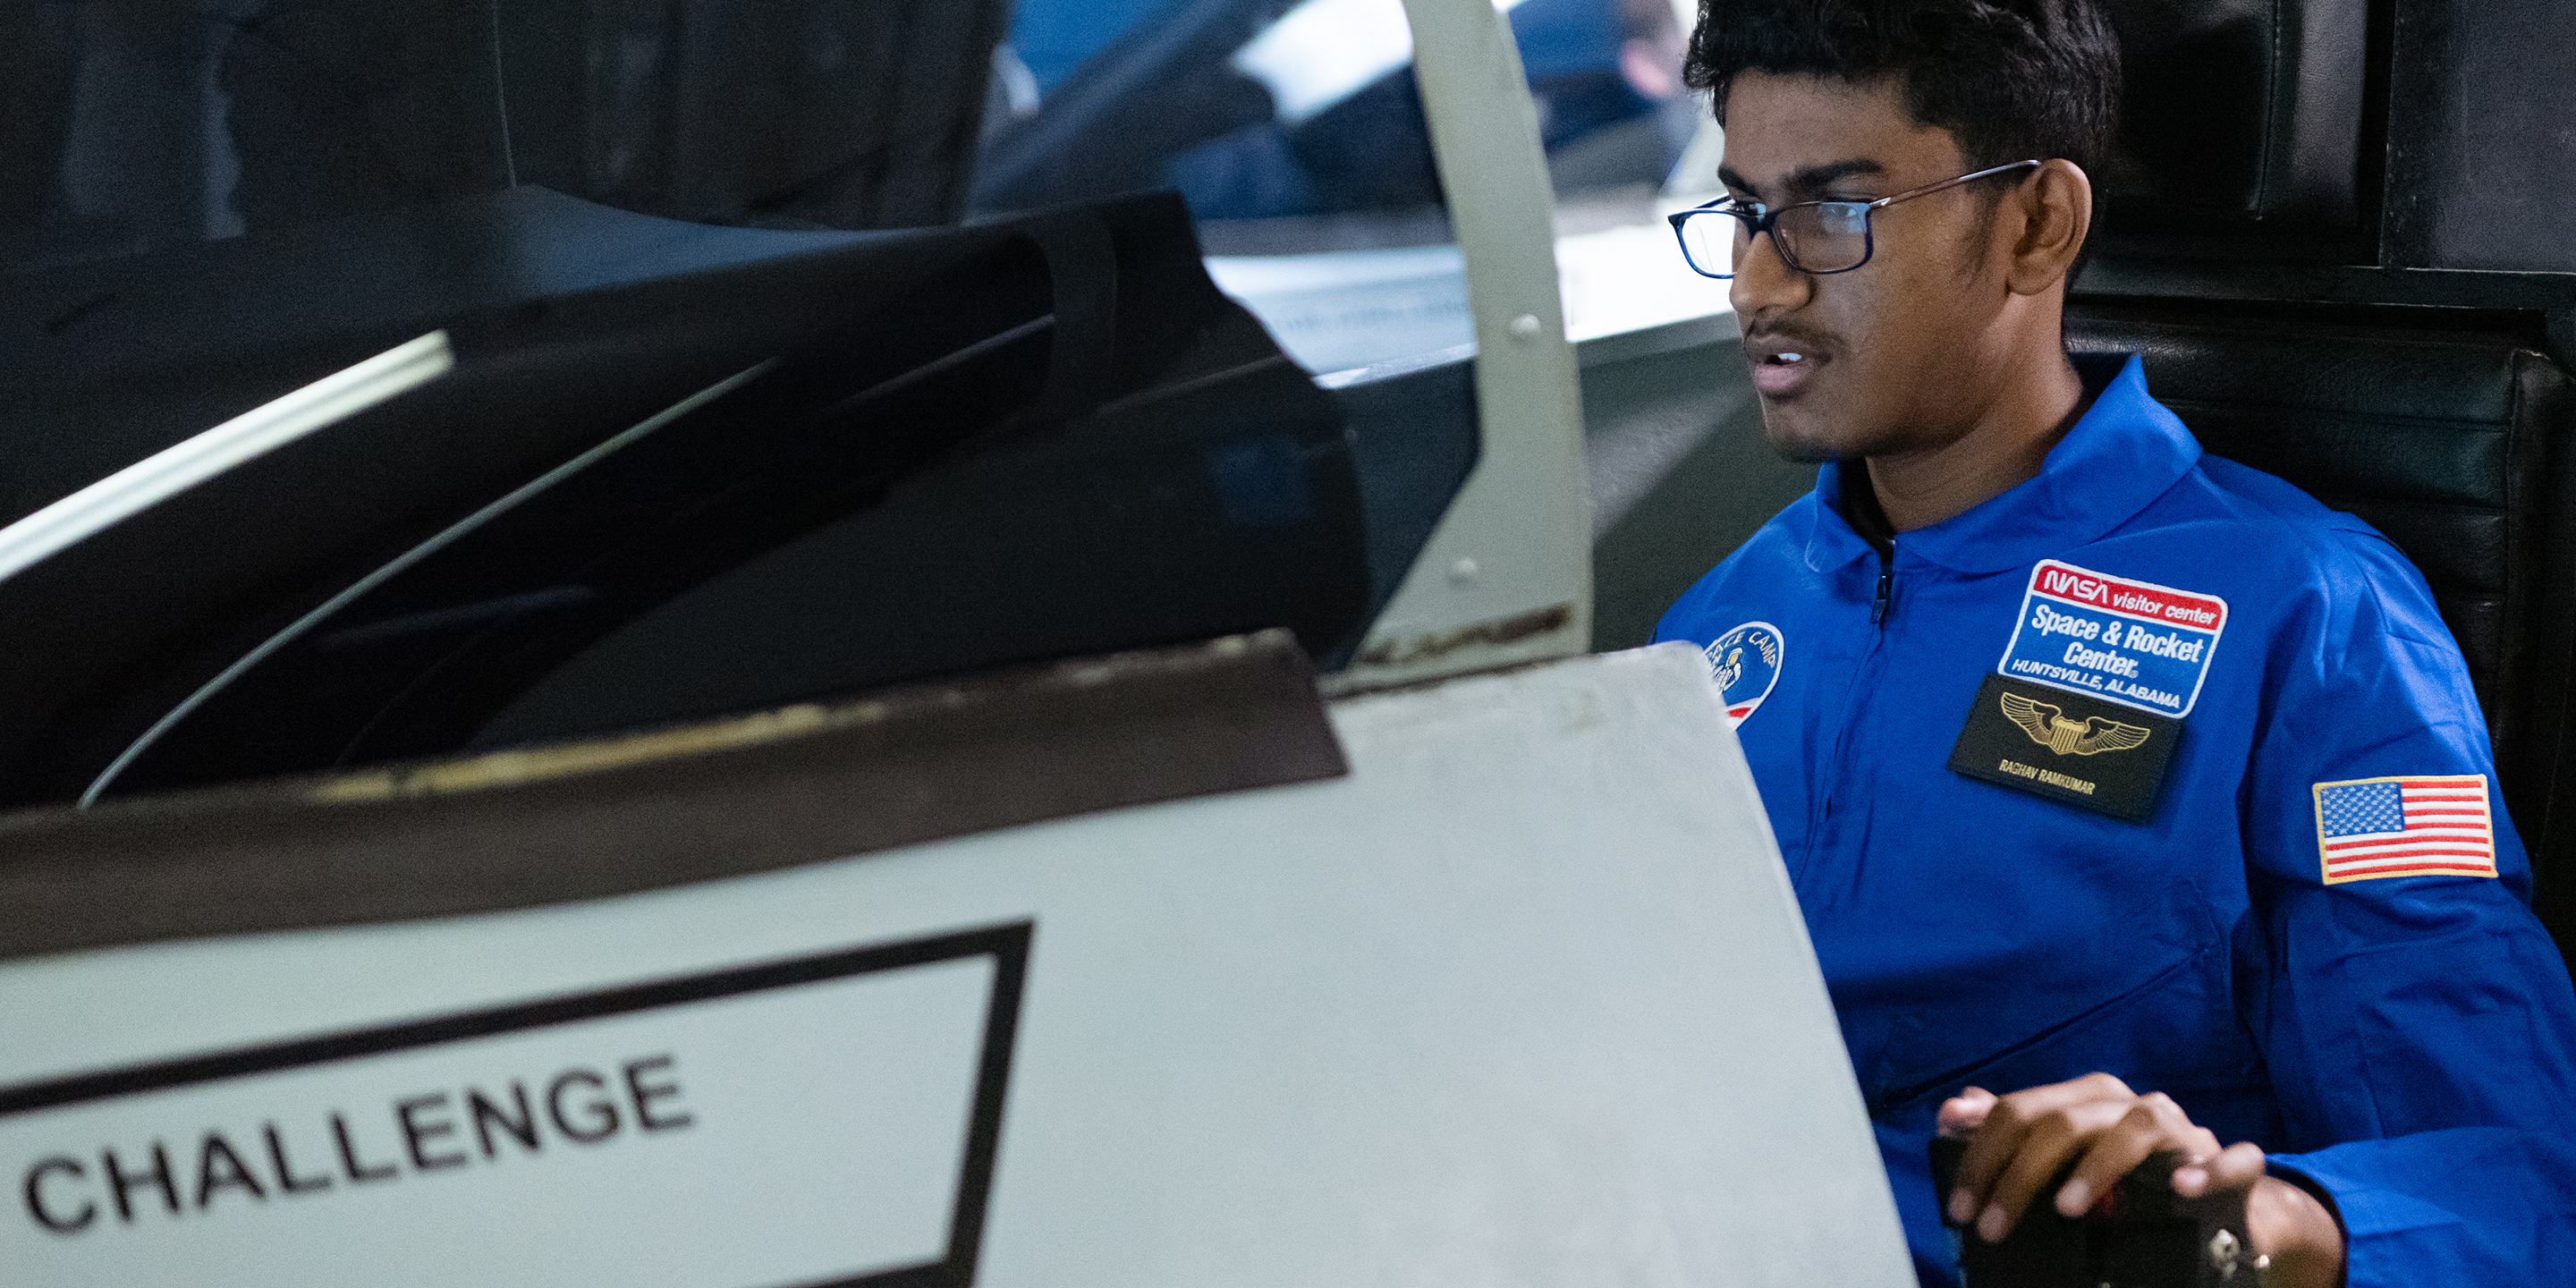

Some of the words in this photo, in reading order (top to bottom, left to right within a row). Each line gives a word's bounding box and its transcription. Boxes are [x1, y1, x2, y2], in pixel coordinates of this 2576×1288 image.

[2043, 570, 2108, 604] NASA
[2113, 594, 2163, 614] visitor
[2165, 605, 2217, 625] center
[1749, 631, 1776, 668] CAMP
[2031, 604, 2100, 640] Space
[2102, 621, 2123, 646] &
[2123, 625, 2204, 664] Rocket
[2012, 658, 2103, 691] HUNTSVILLE,
[2105, 678, 2181, 709] ALABAMA
[1998, 759, 2038, 780] RAGHAV
[2038, 769, 2096, 795] RAMKUMAR
[22, 1055, 697, 1234] CHALLENGE
